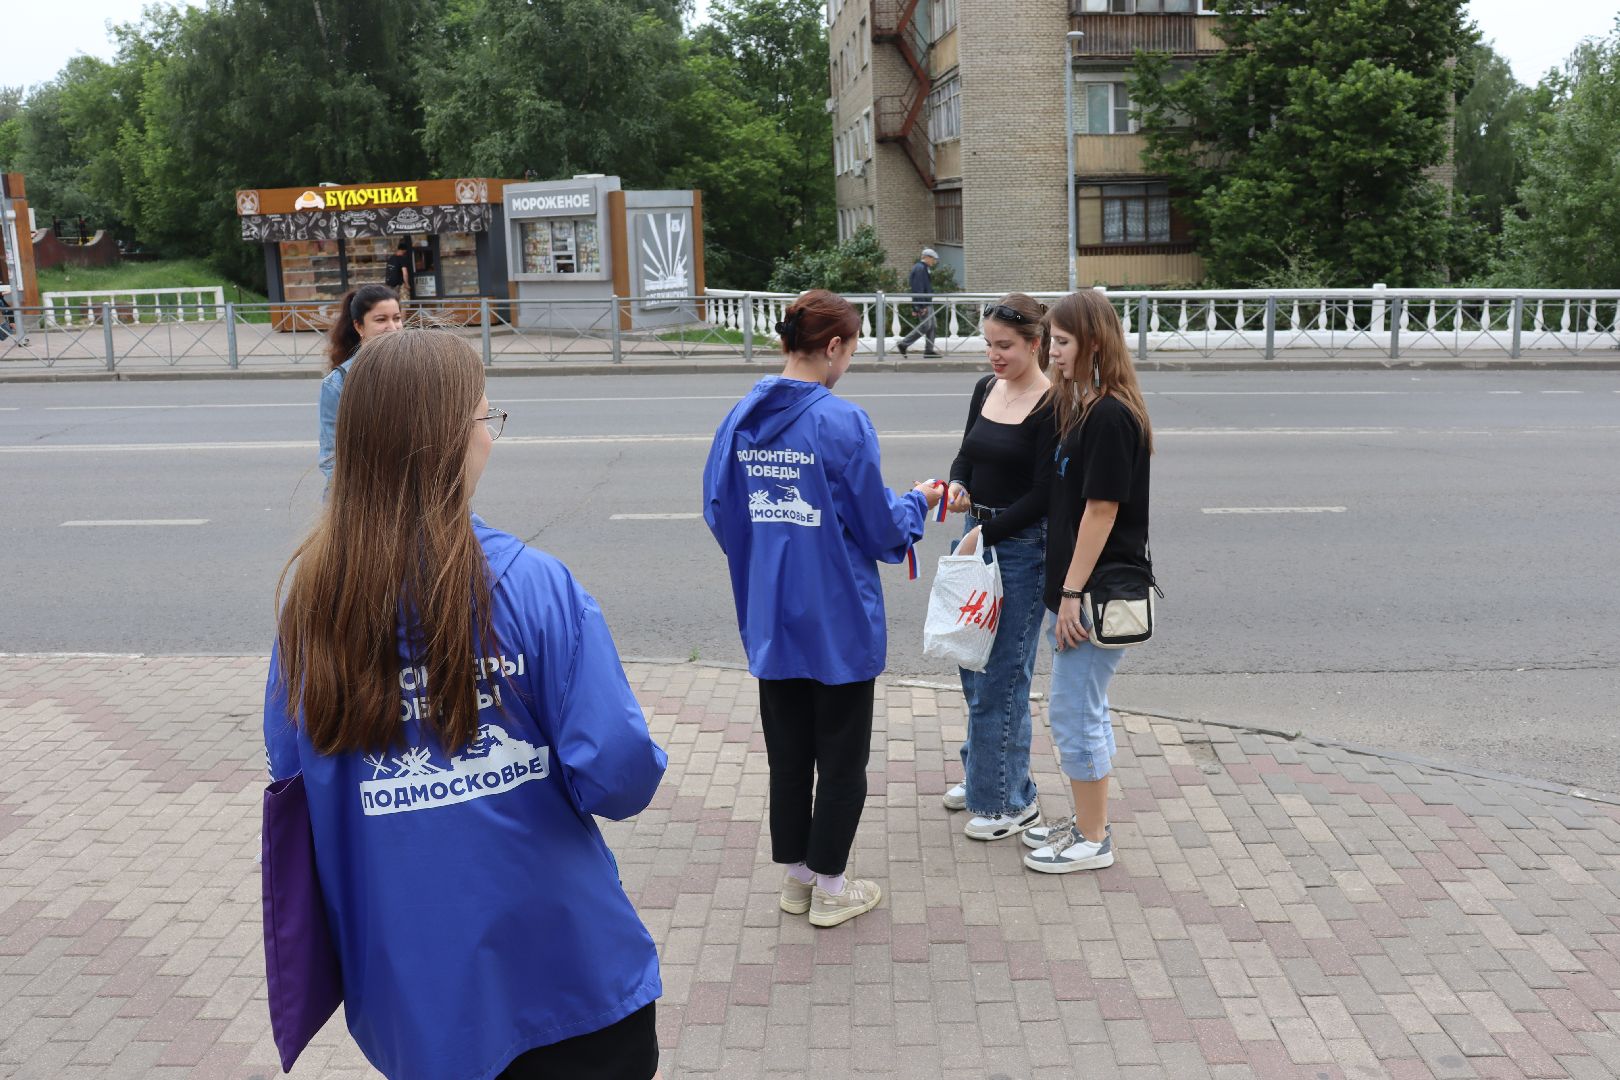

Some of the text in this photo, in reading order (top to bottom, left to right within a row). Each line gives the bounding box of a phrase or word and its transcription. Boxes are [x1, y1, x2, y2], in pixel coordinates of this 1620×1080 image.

[325, 186, 418, 210] БУЛОЧНАЯ
[512, 193, 590, 212] МОРОЖЕНОЕ
[364, 756, 543, 809] ПОДМОСКОВЬЕ
